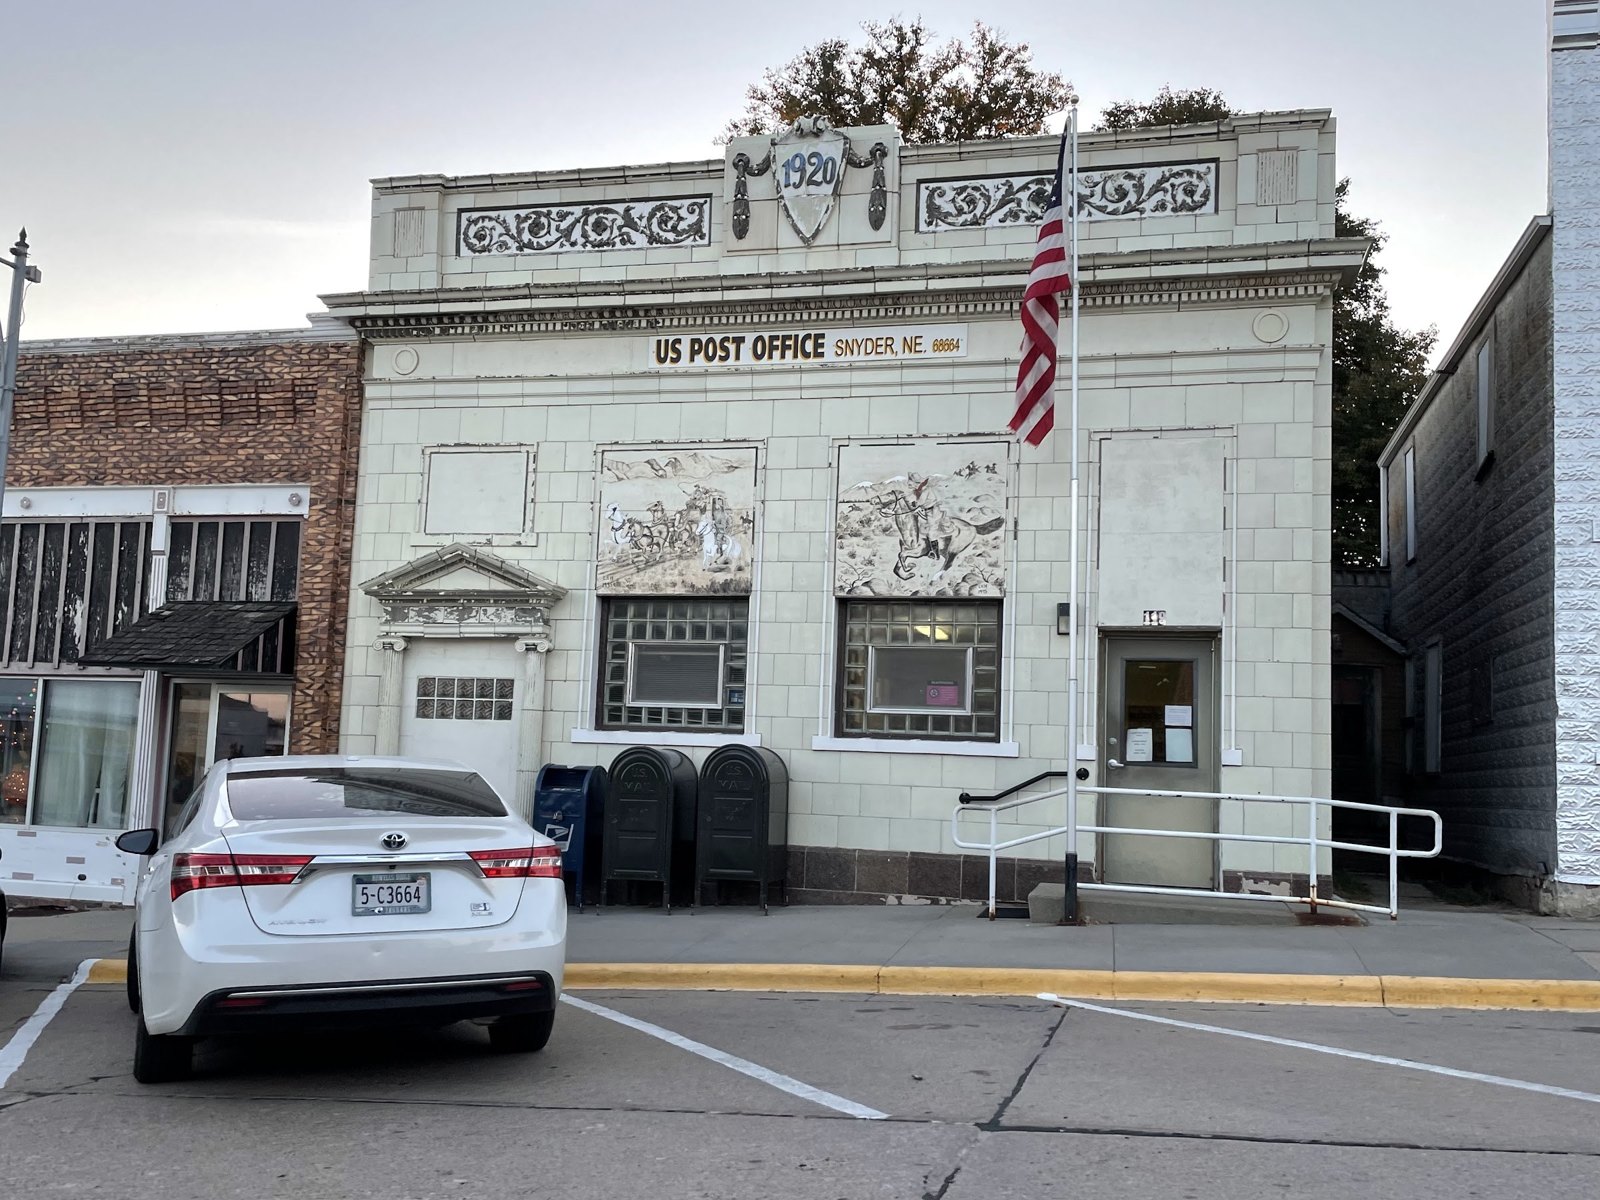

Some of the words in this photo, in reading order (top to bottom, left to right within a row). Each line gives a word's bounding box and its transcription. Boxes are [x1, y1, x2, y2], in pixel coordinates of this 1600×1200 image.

[781, 151, 837, 189] 1920
[656, 337, 682, 364] US
[689, 335, 746, 363] POST
[752, 332, 826, 361] OFFICE
[834, 337, 898, 357] SNYDER,
[902, 335, 927, 354] NE.
[932, 337, 960, 352] 68664
[361, 885, 421, 905] 5-C3664
